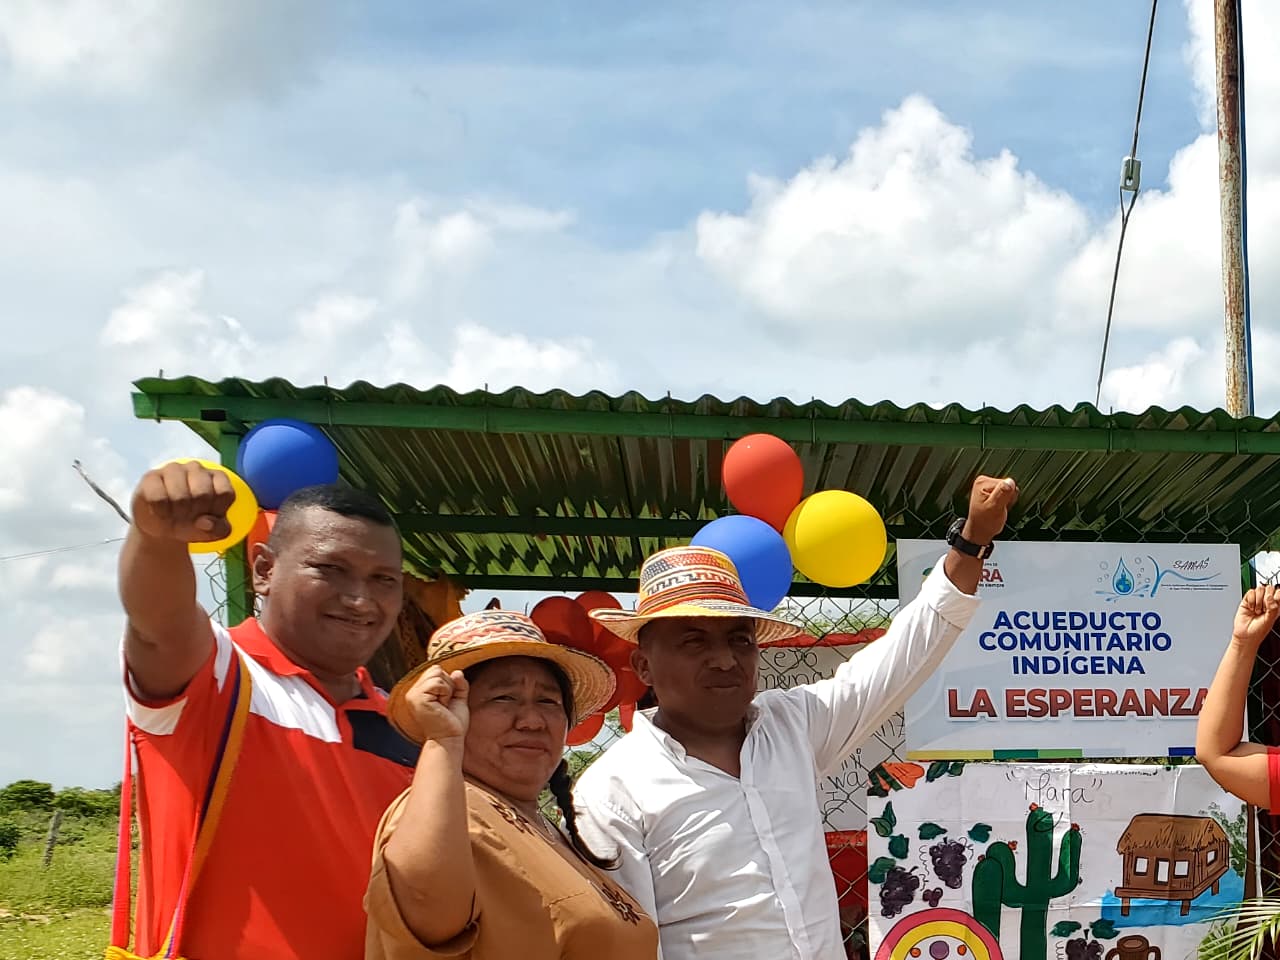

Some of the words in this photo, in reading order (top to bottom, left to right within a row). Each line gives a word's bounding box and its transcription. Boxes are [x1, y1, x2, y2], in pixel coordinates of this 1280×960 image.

[993, 611, 1162, 631] ACUEDUCTO
[978, 632, 1172, 653] COMUNITARIO
[1012, 651, 1146, 675] INDÍGENA
[947, 688, 997, 718] LA
